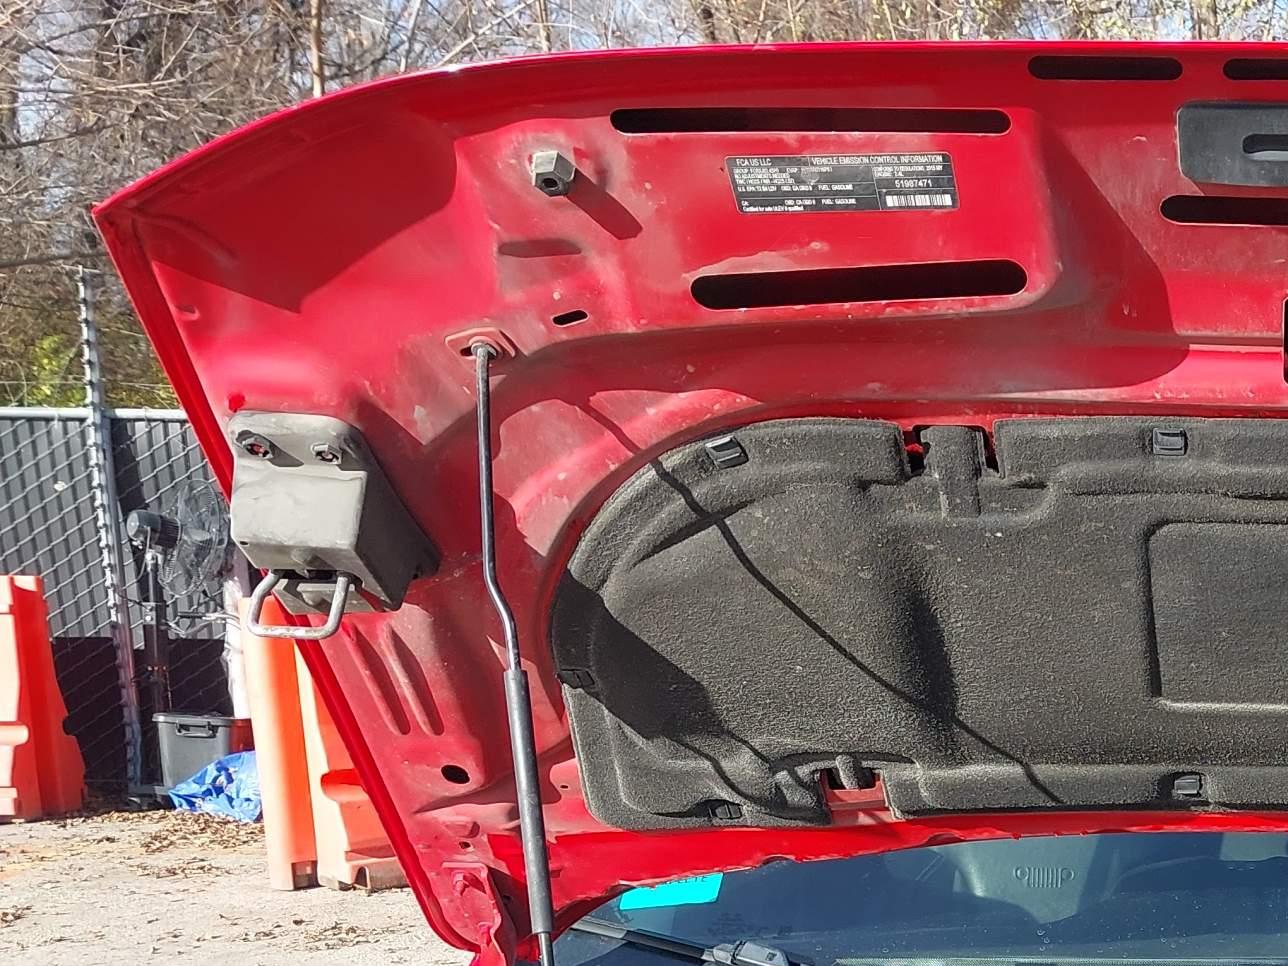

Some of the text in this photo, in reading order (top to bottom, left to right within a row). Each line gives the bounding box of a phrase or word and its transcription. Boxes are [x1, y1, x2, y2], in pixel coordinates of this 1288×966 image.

[736, 158, 772, 167] FCA US LLC
[812, 155, 943, 165] VEHICLE EMISSION CONTROL INFORMATION
